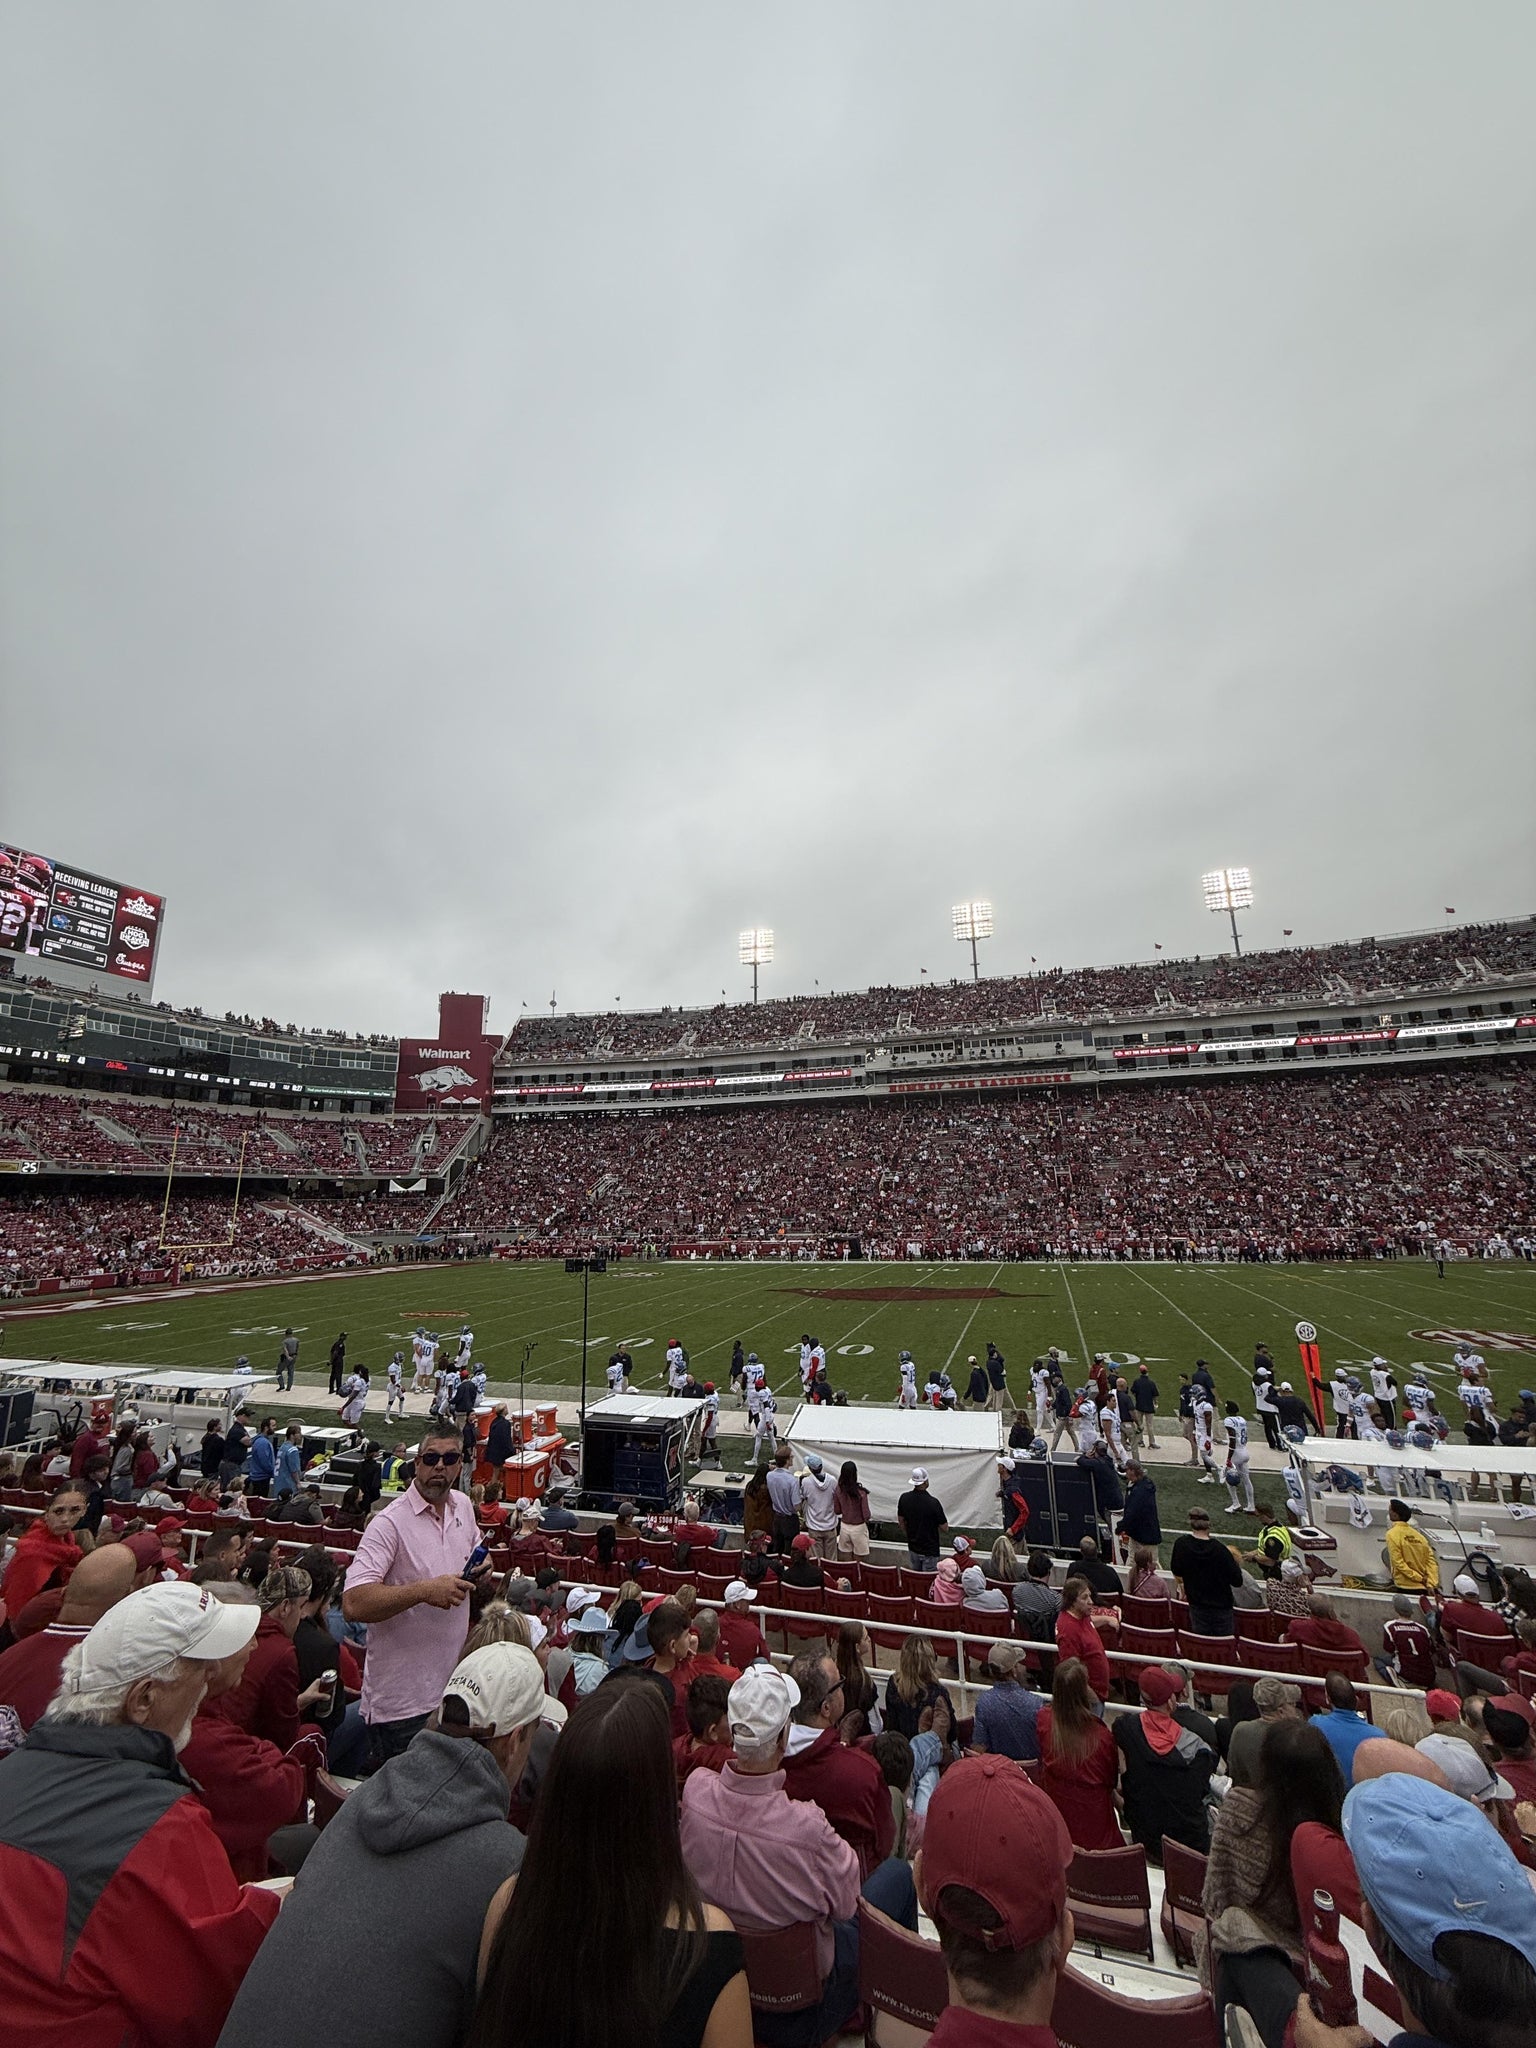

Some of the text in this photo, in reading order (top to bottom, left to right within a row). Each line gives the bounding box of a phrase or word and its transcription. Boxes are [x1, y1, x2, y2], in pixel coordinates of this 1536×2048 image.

[54, 872, 118, 898] RECEIVING LEADERS
[418, 1048, 470, 1060] Walmart
[929, 1082, 944, 1090] OF
[950, 1080, 975, 1088] THE
[980, 1074, 1072, 1087] RAZORBACKS
[22, 1162, 37, 1172] 25
[70, 1279, 93, 1288] Ritter
[1300, 1324, 1314, 1339] SEC
[751, 1371, 763, 1384] 72
[513, 1422, 521, 1432] G
[538, 1415, 544, 1424] G
[534, 1465, 545, 1488] G
[1408, 1638, 1418, 1655] 1
[450, 1676, 480, 1696] ZETA DAD
[1066, 1884, 1139, 1900] razorbackseats.com
[750, 1992, 802, 2004] seats.com
[872, 1988, 940, 2023] www.razorba
